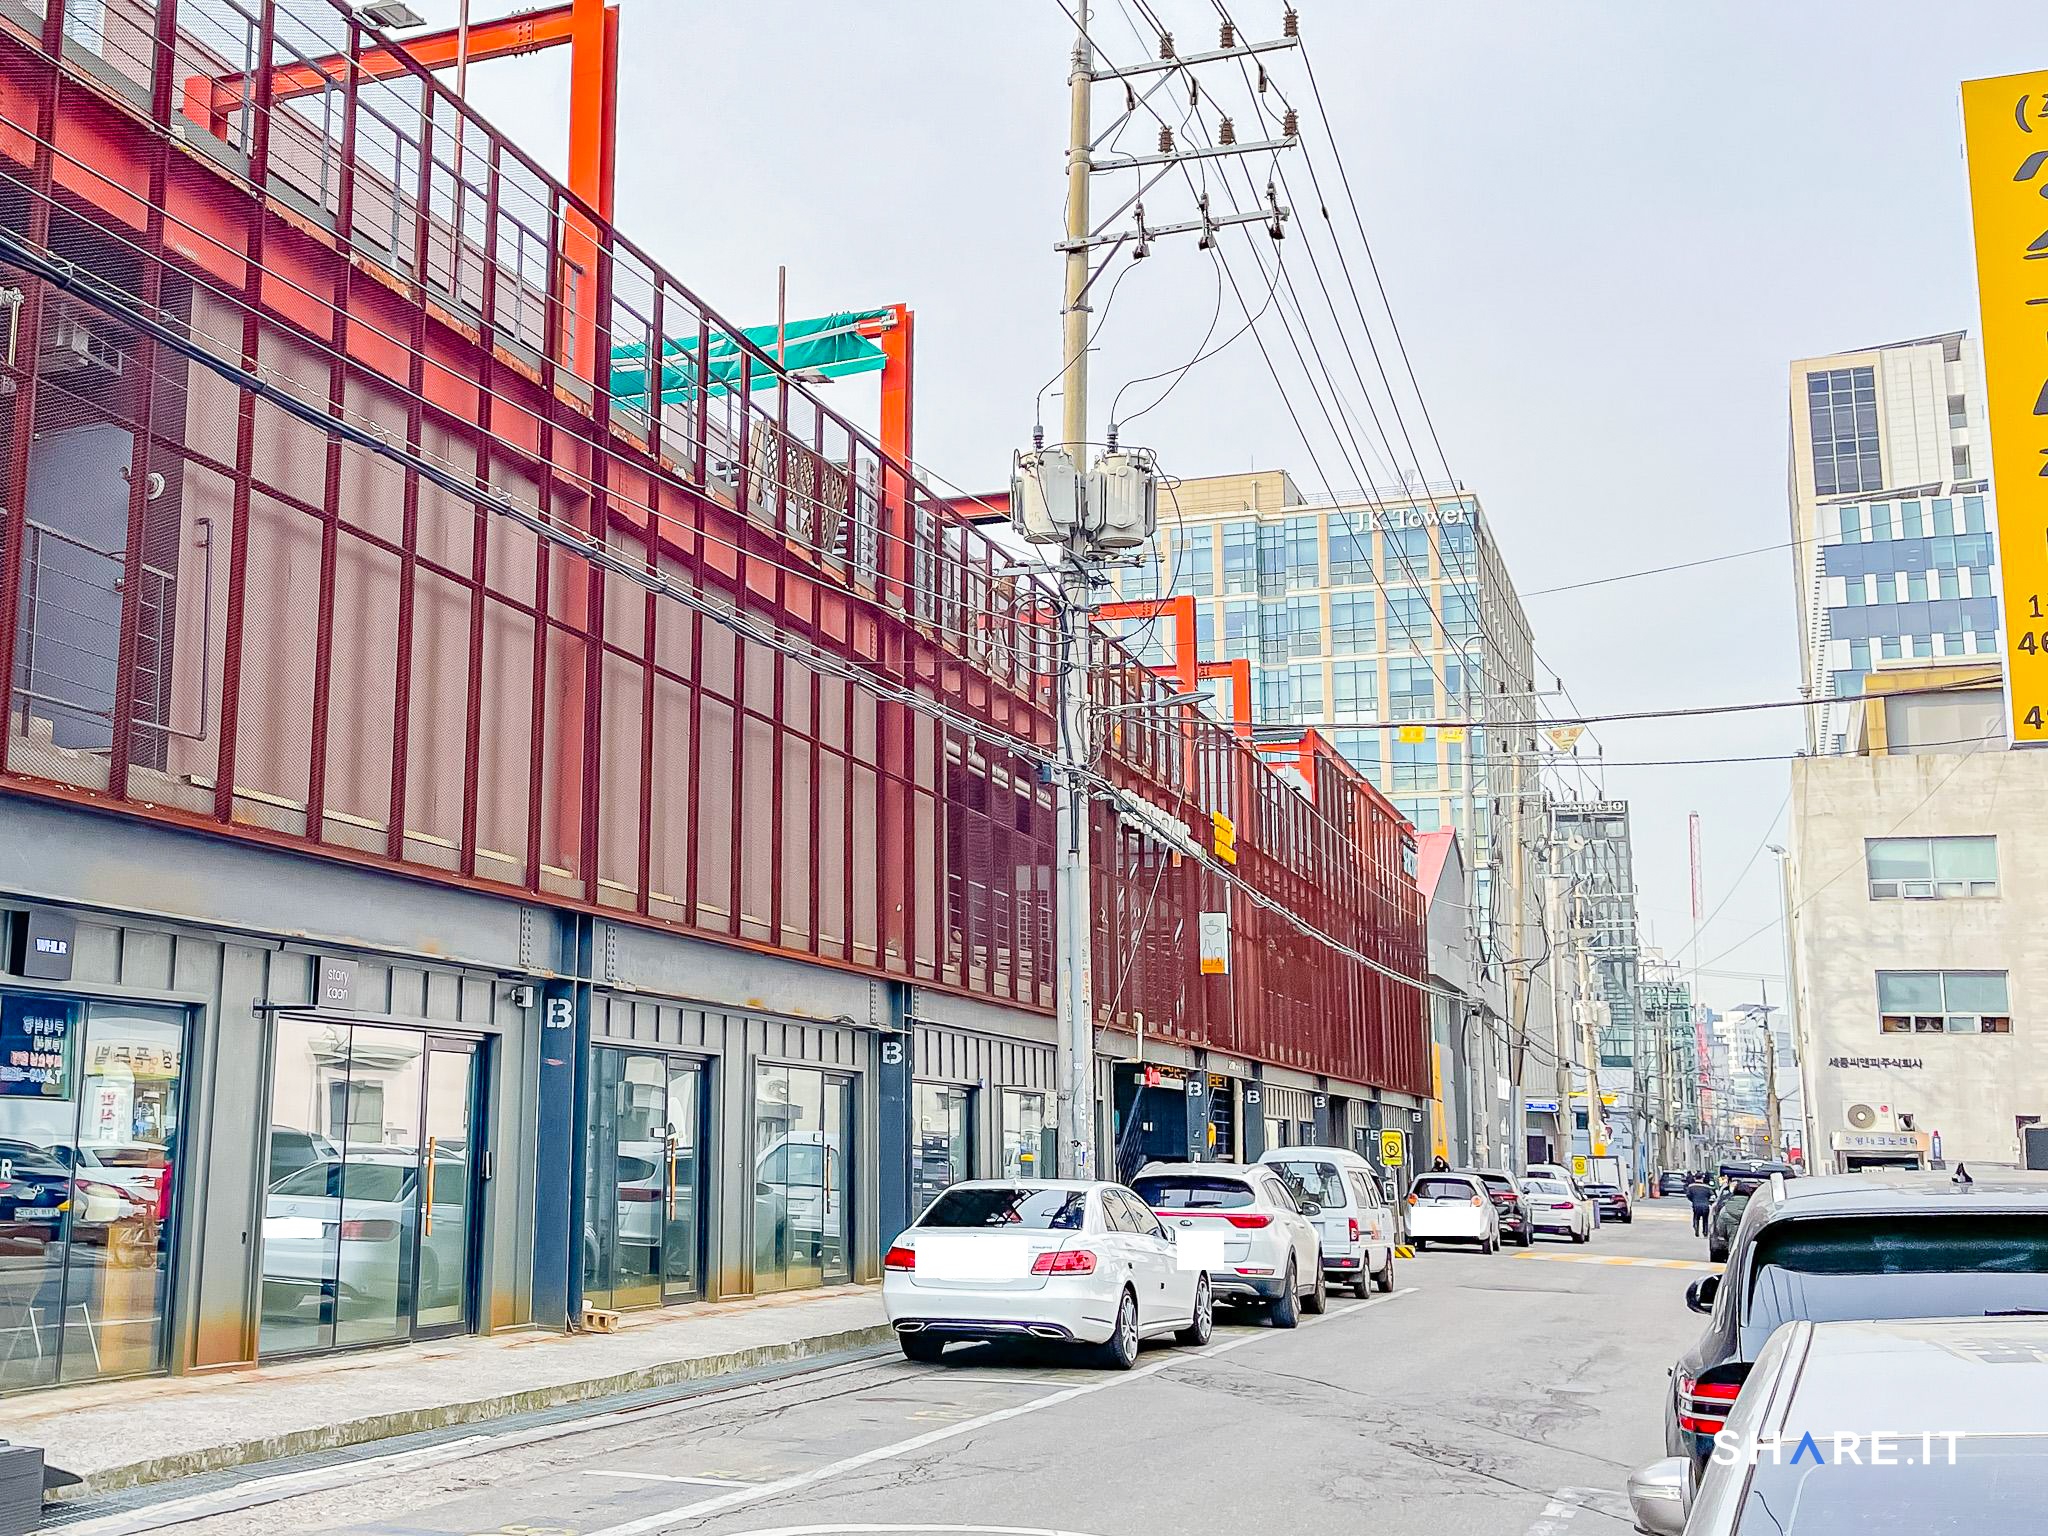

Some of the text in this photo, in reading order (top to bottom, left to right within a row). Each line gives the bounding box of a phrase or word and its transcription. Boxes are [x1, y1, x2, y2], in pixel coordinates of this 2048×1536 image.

[1354, 506, 1469, 532] JK Tower
[328, 969, 350, 986] story
[546, 998, 573, 1029] B
[882, 1041, 903, 1065] B
[1188, 1081, 1203, 1097] B
[1247, 1090, 1261, 1104] B
[1314, 1096, 1326, 1108] B
[1412, 1112, 1422, 1122] B
